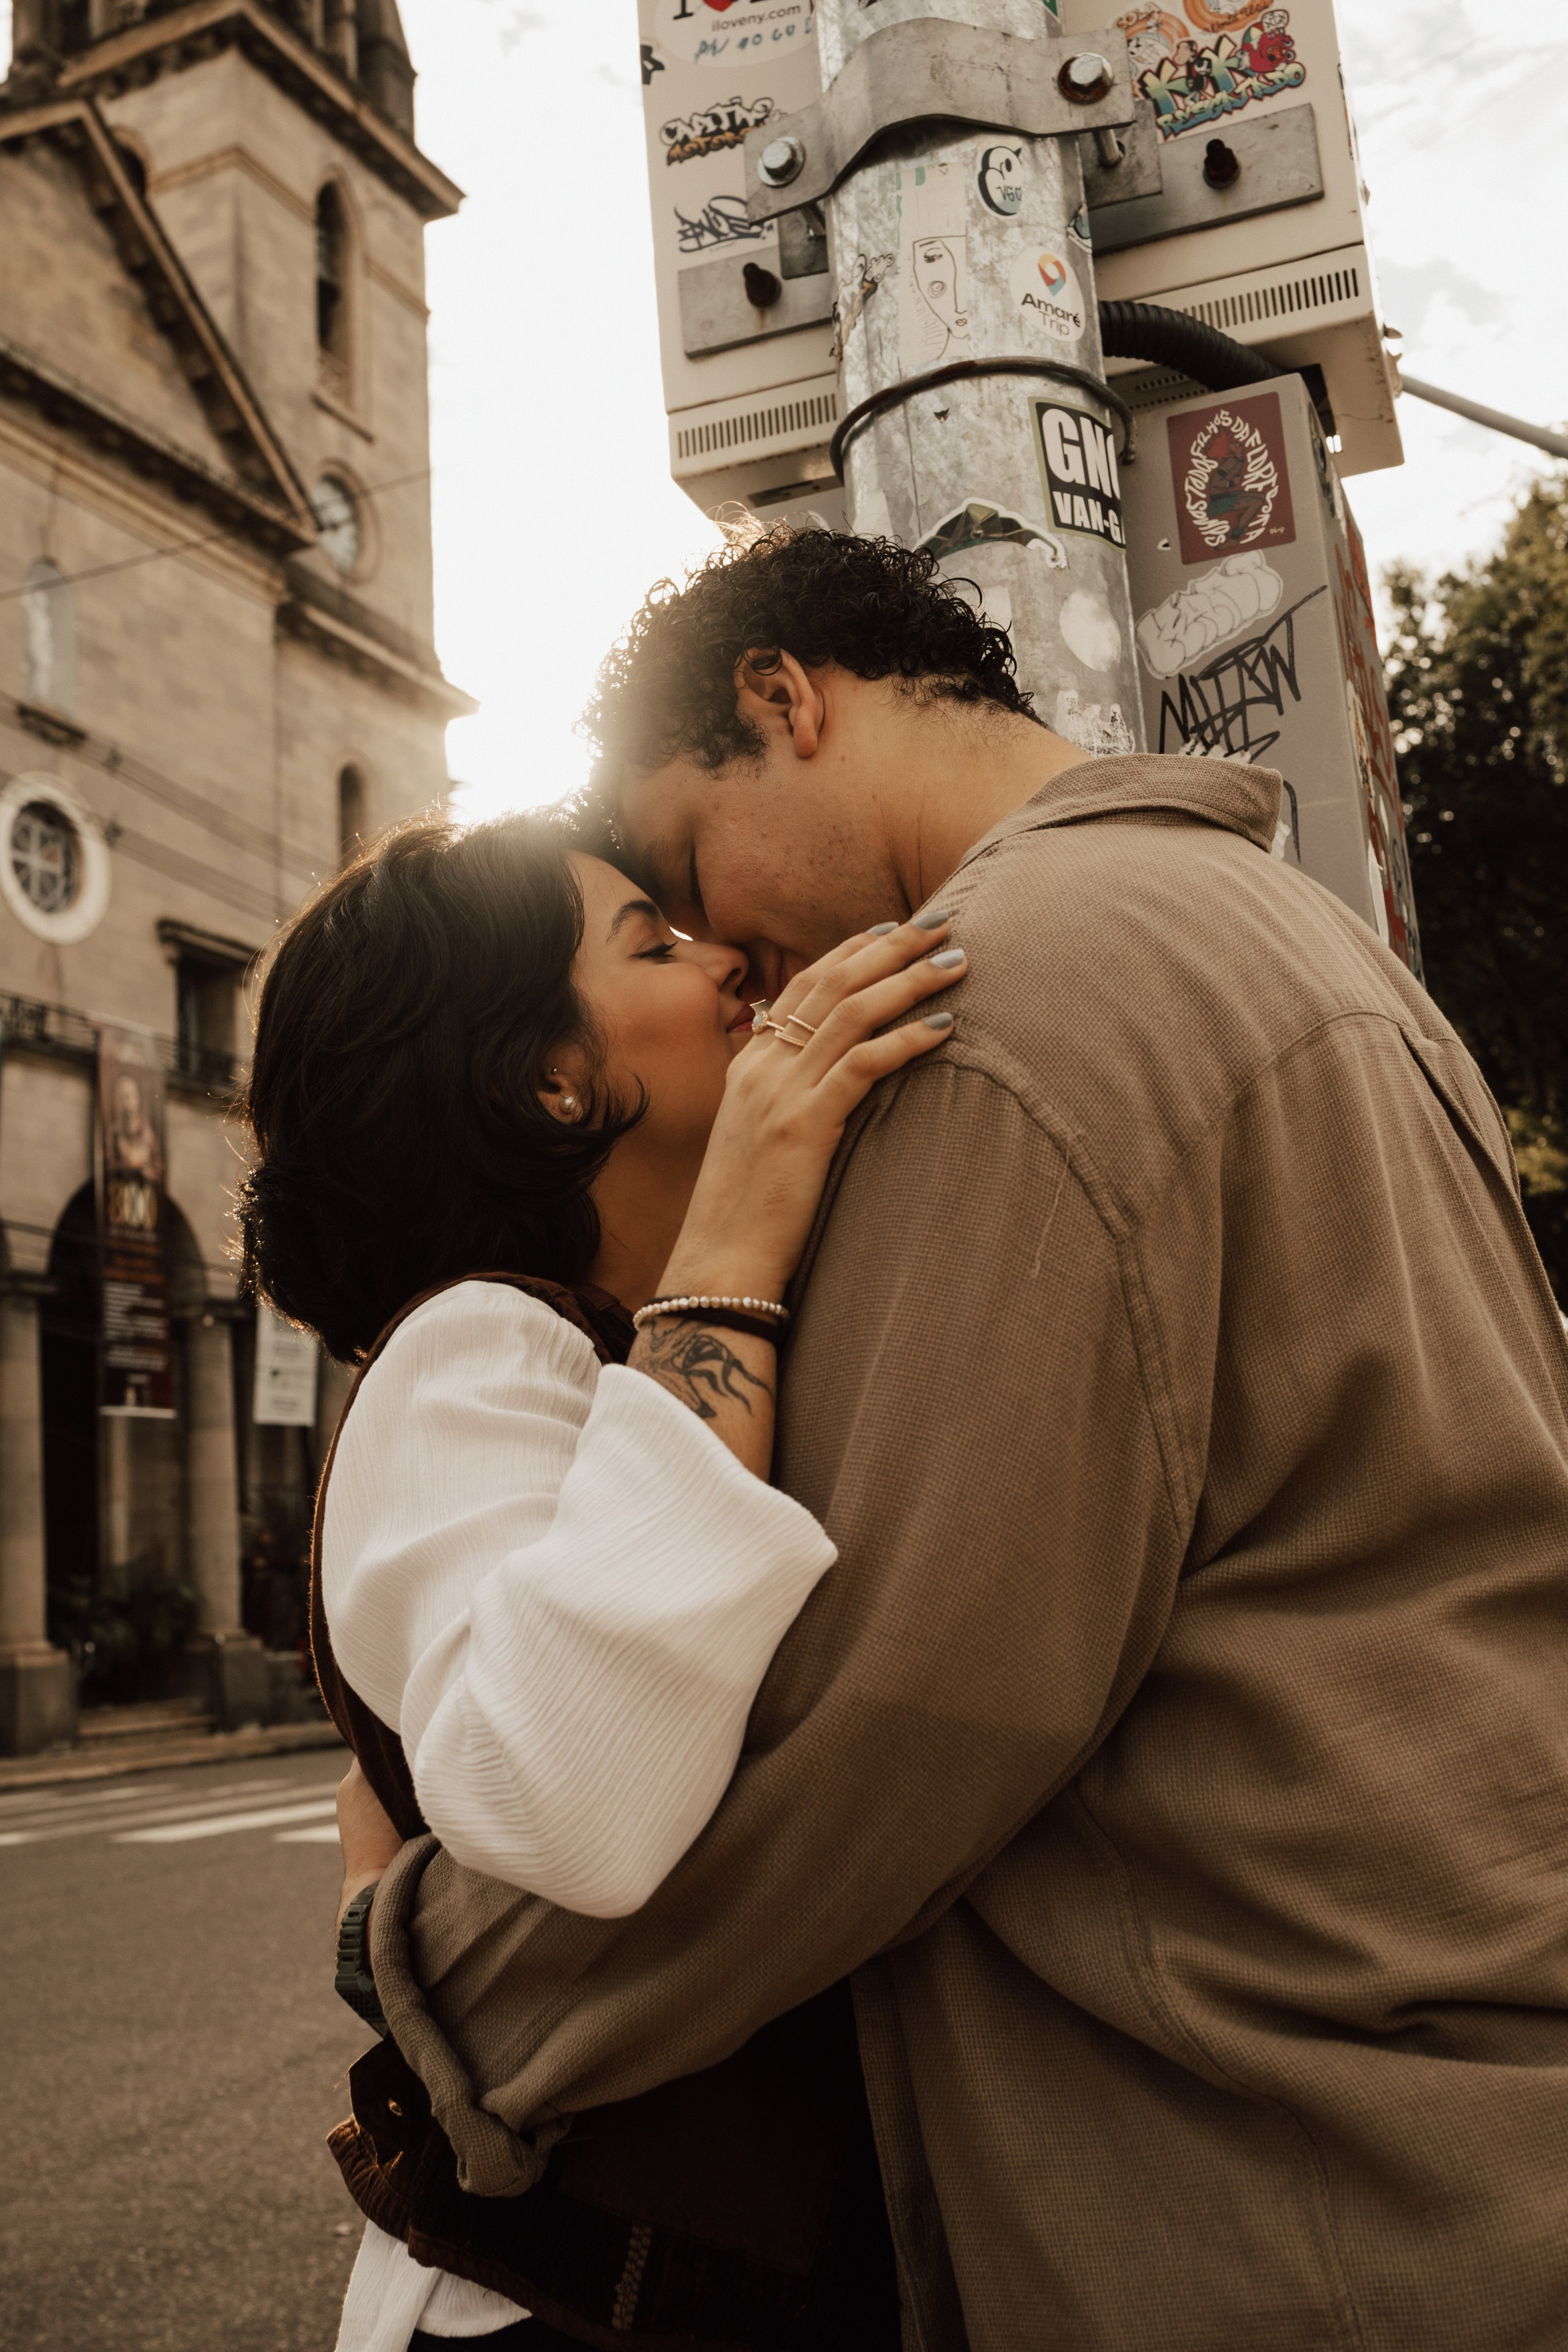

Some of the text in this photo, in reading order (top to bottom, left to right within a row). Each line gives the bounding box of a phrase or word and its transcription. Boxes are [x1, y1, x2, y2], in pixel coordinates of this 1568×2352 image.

[711, 4, 801, 32] iloveny.com
[1021, 293, 1081, 328] Amaré
[1039, 310, 1070, 336] Trip
[1230, 415, 1251, 442] DA
[1238, 427, 1280, 545] FLORESTA
[1052, 491, 1126, 545] VAN-G
